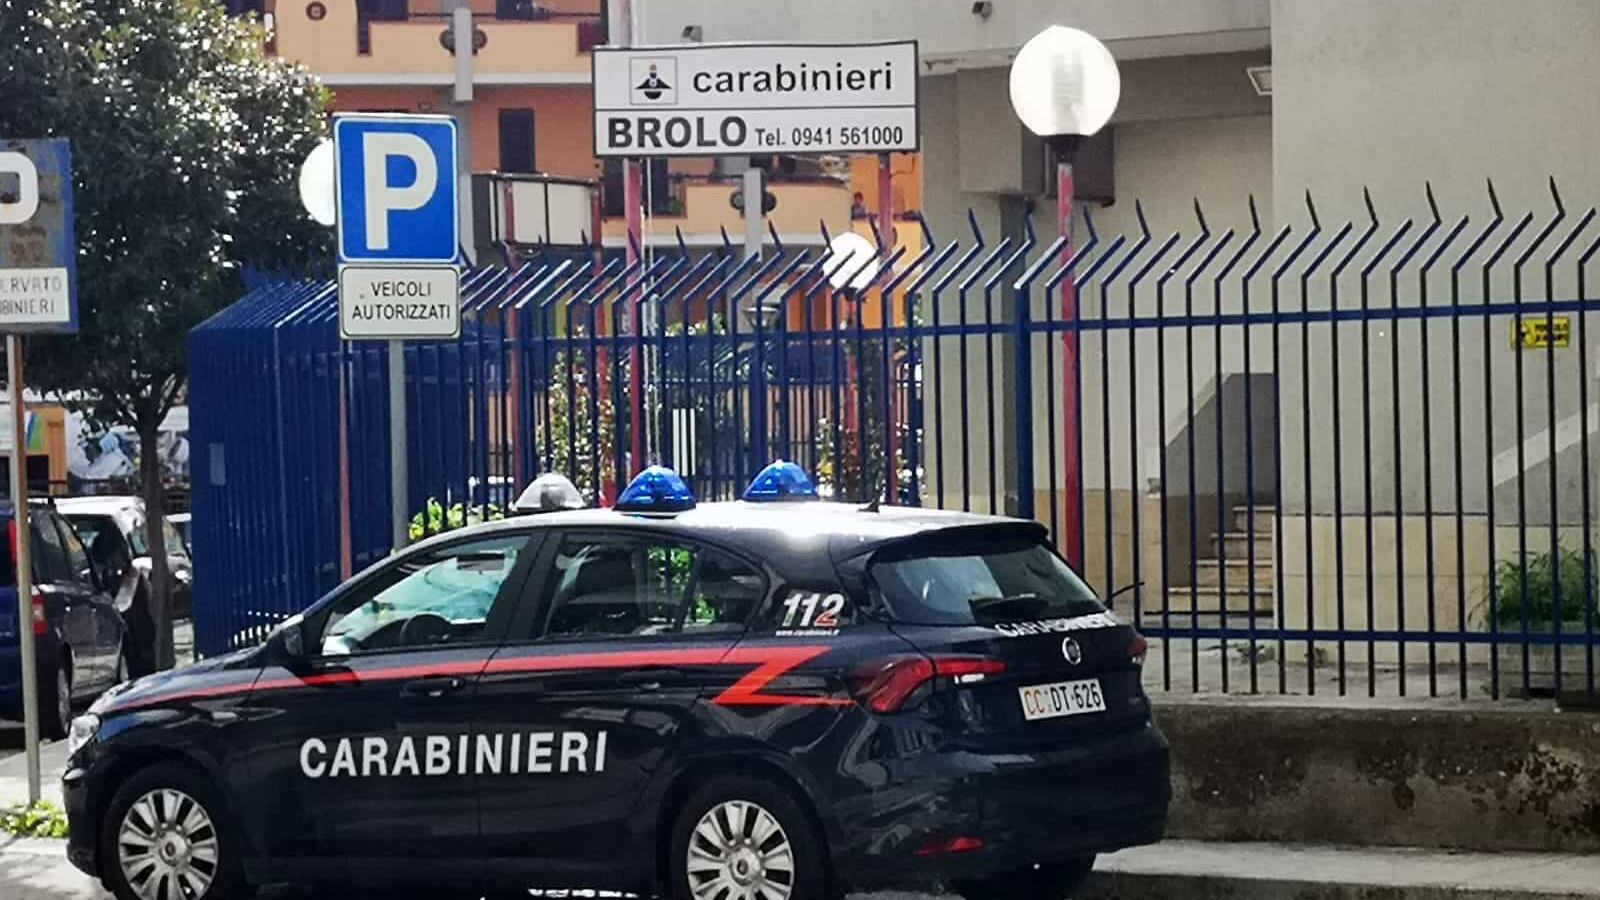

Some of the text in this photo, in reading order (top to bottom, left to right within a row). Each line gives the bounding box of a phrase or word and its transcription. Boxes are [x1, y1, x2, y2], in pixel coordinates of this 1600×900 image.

[693, 62, 892, 93] carabinieri
[607, 116, 903, 148] BROLO Tel. 0941 561000
[363, 131, 438, 250] P
[371, 281, 431, 297] VEICOLI
[352, 304, 450, 320] AUTORIZZATI
[782, 593, 844, 627] 112
[300, 731, 607, 778] CARABINIERI
